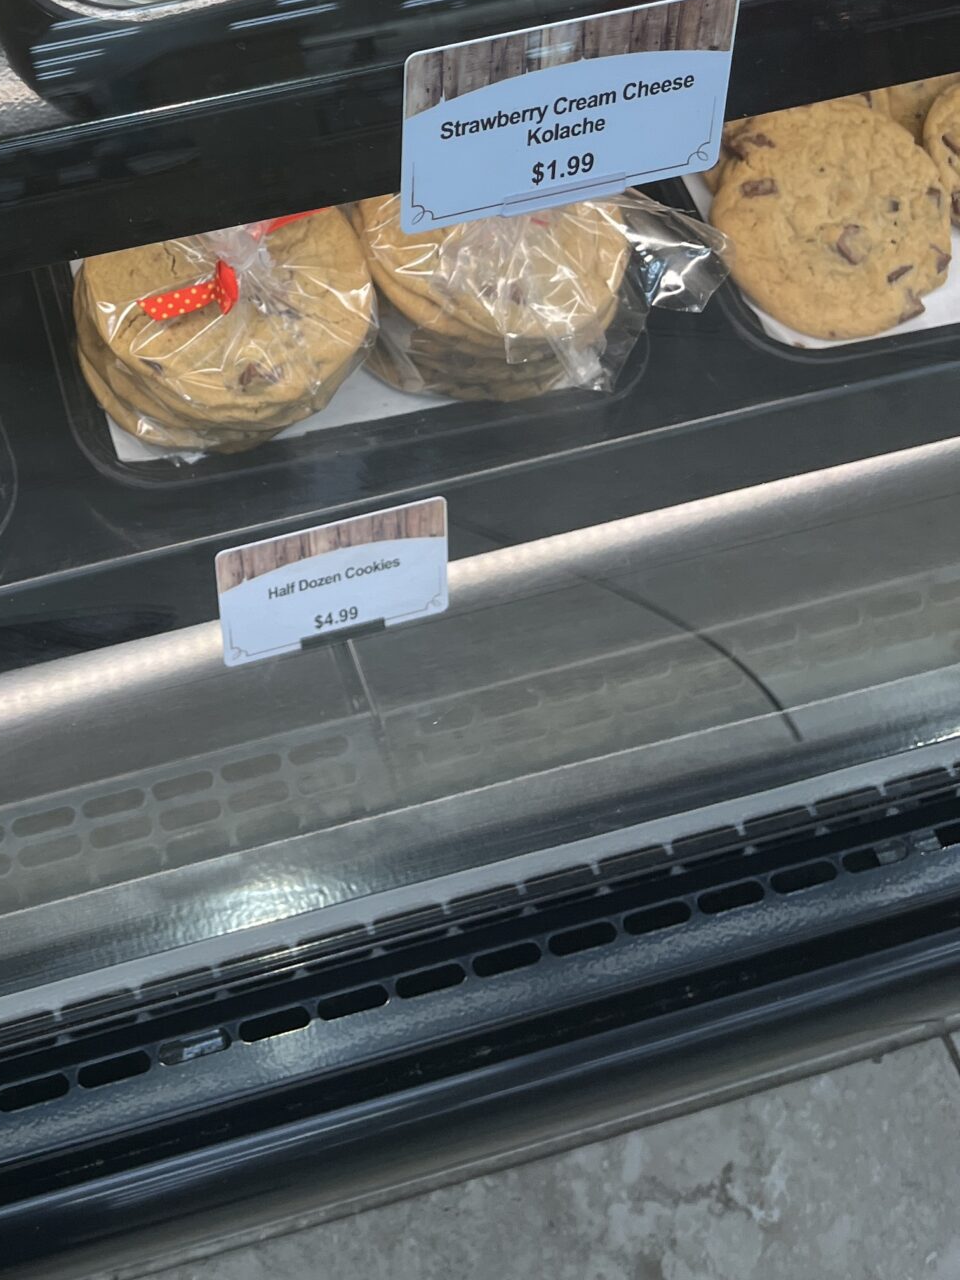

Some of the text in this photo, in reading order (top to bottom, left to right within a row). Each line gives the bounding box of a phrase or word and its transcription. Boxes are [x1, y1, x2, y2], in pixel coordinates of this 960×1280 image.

[440, 73, 695, 140] Strawberry Cream Cheese
[527, 117, 606, 146] Kolache
[531, 152, 594, 186] $1.99
[268, 556, 401, 600] Half Dozen Cookies
[314, 606, 359, 630] $4.99
